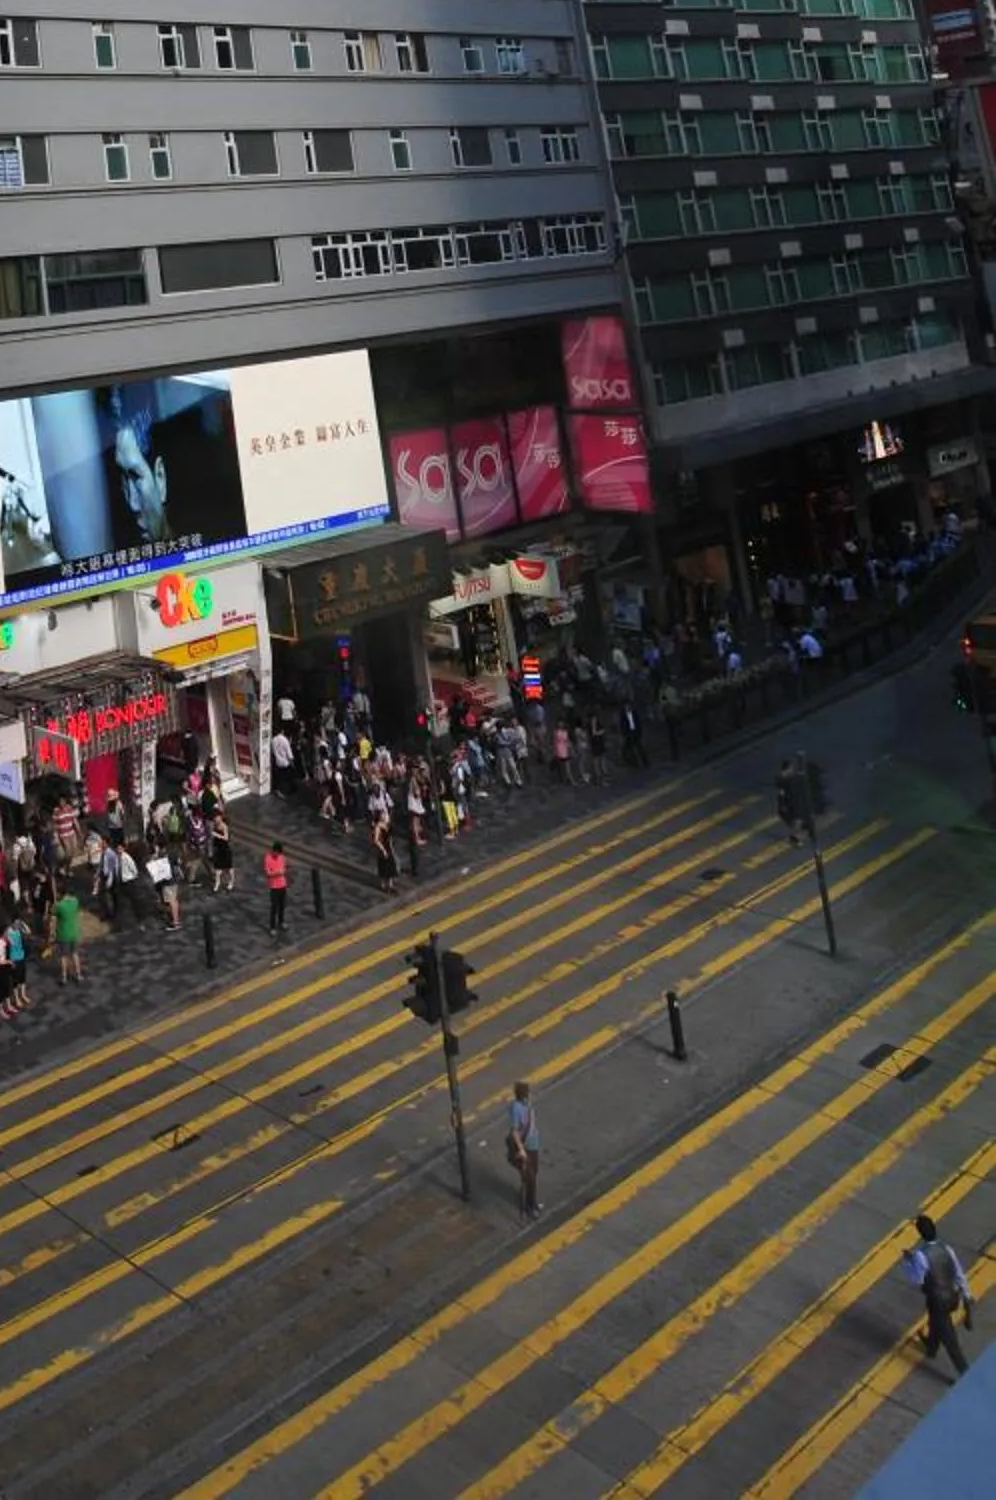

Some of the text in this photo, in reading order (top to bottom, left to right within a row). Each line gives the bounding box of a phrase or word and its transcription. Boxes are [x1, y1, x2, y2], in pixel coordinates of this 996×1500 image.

[571, 376, 632, 400] sasa
[397, 442, 505, 514] sasa
[95, 692, 167, 732] BONJOUR
